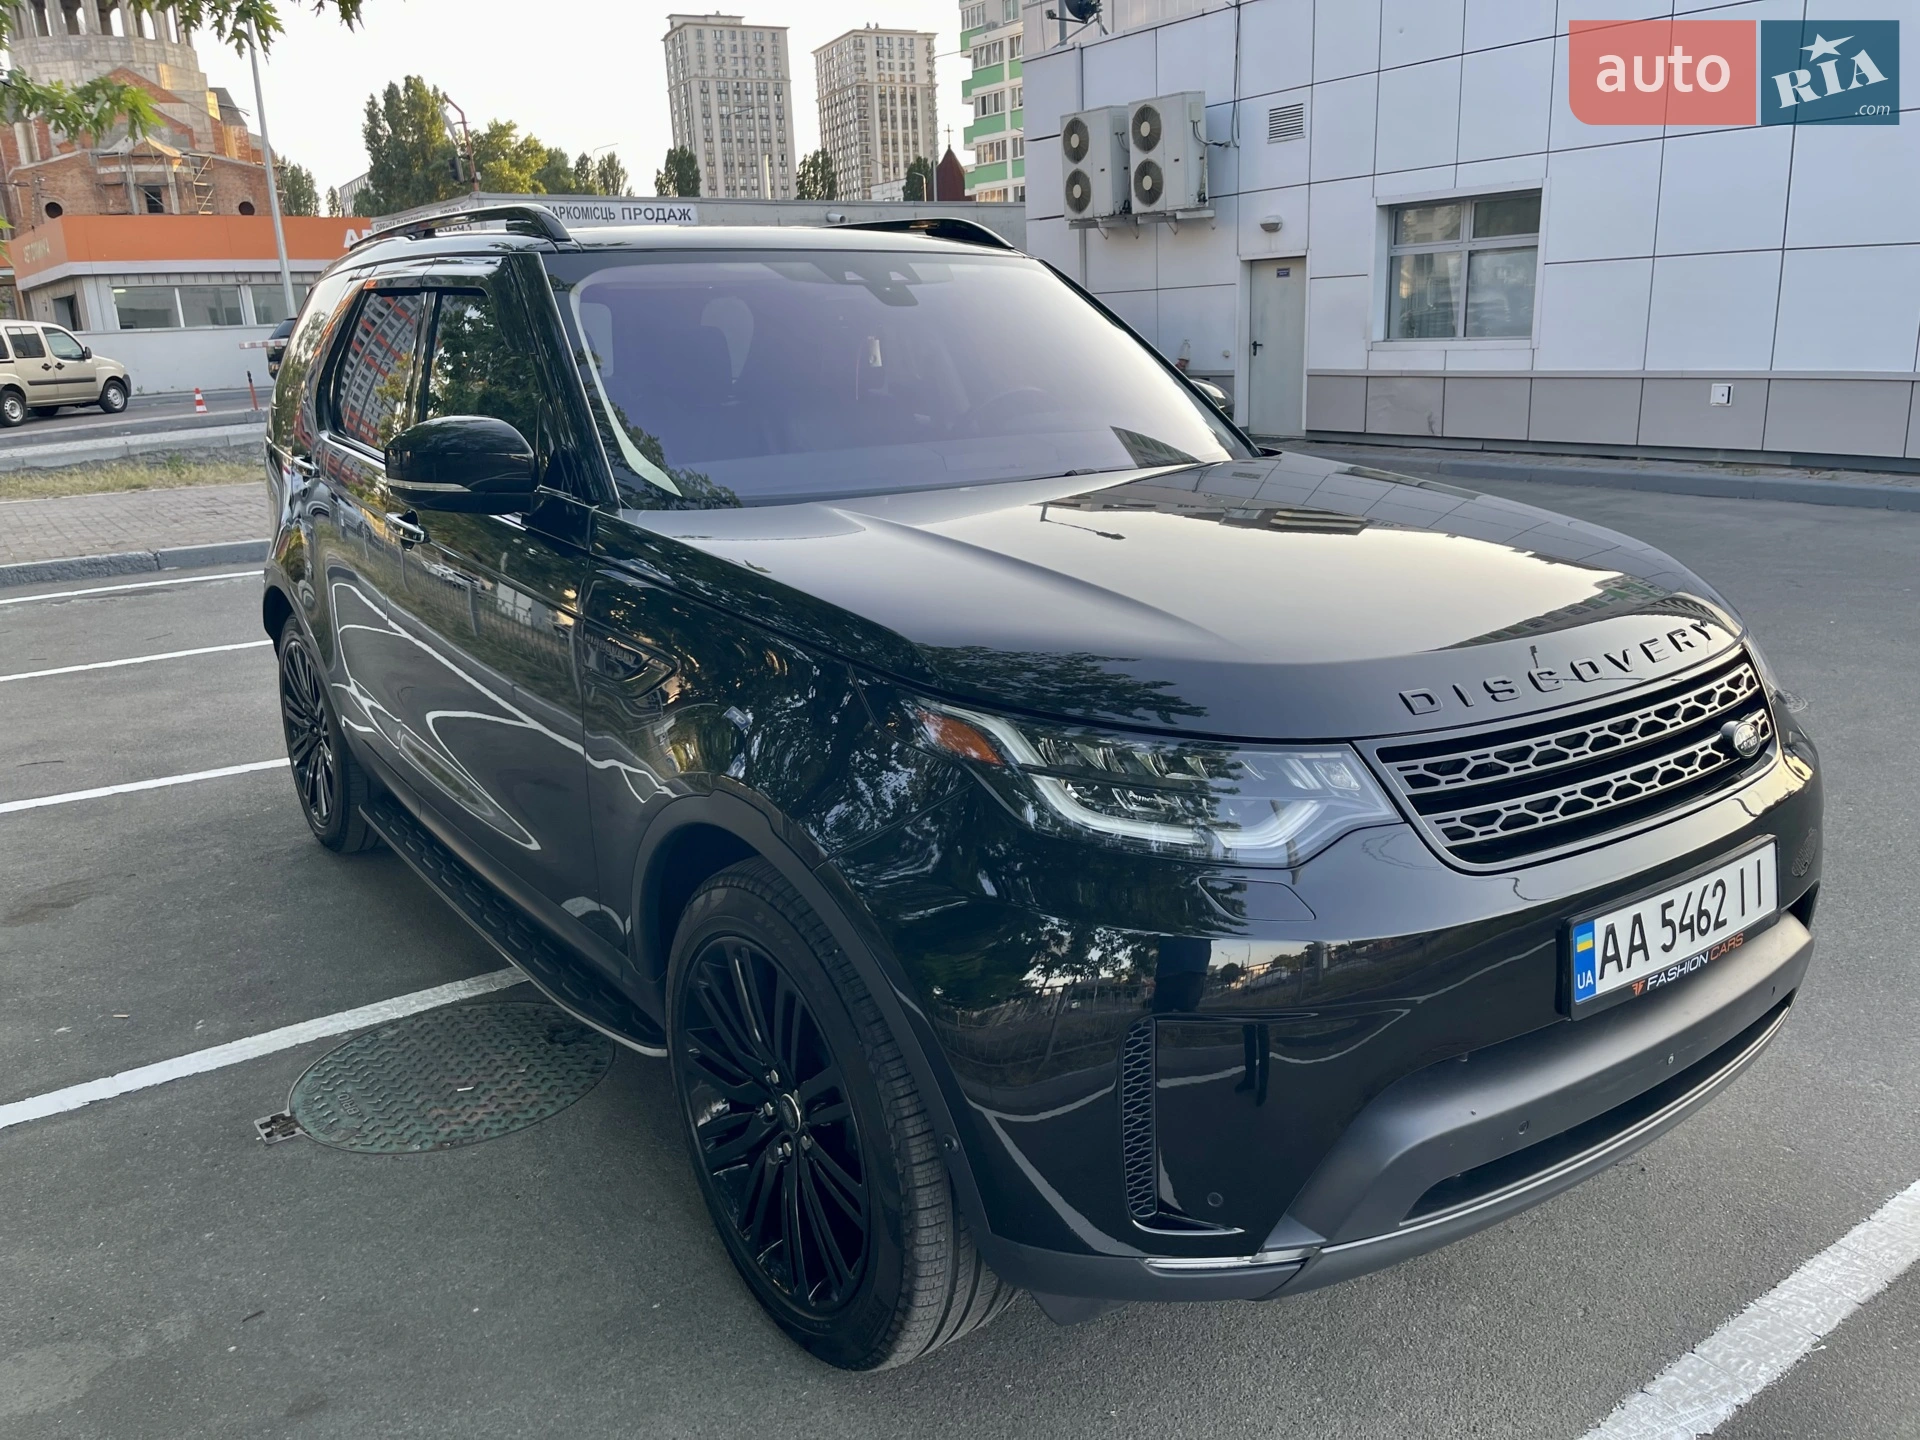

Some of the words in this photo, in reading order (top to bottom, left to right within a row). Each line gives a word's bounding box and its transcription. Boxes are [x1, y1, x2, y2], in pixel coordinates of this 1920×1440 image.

[621, 206, 692, 223] ПРОДАЖ
[1398, 622, 1717, 716] DISCOVERY
[1598, 912, 1650, 981] AA
[1660, 878, 1728, 953] 5462
[1577, 969, 1594, 990] UA
[1646, 951, 1709, 991] FASHION
[1710, 932, 1744, 961] CARS
